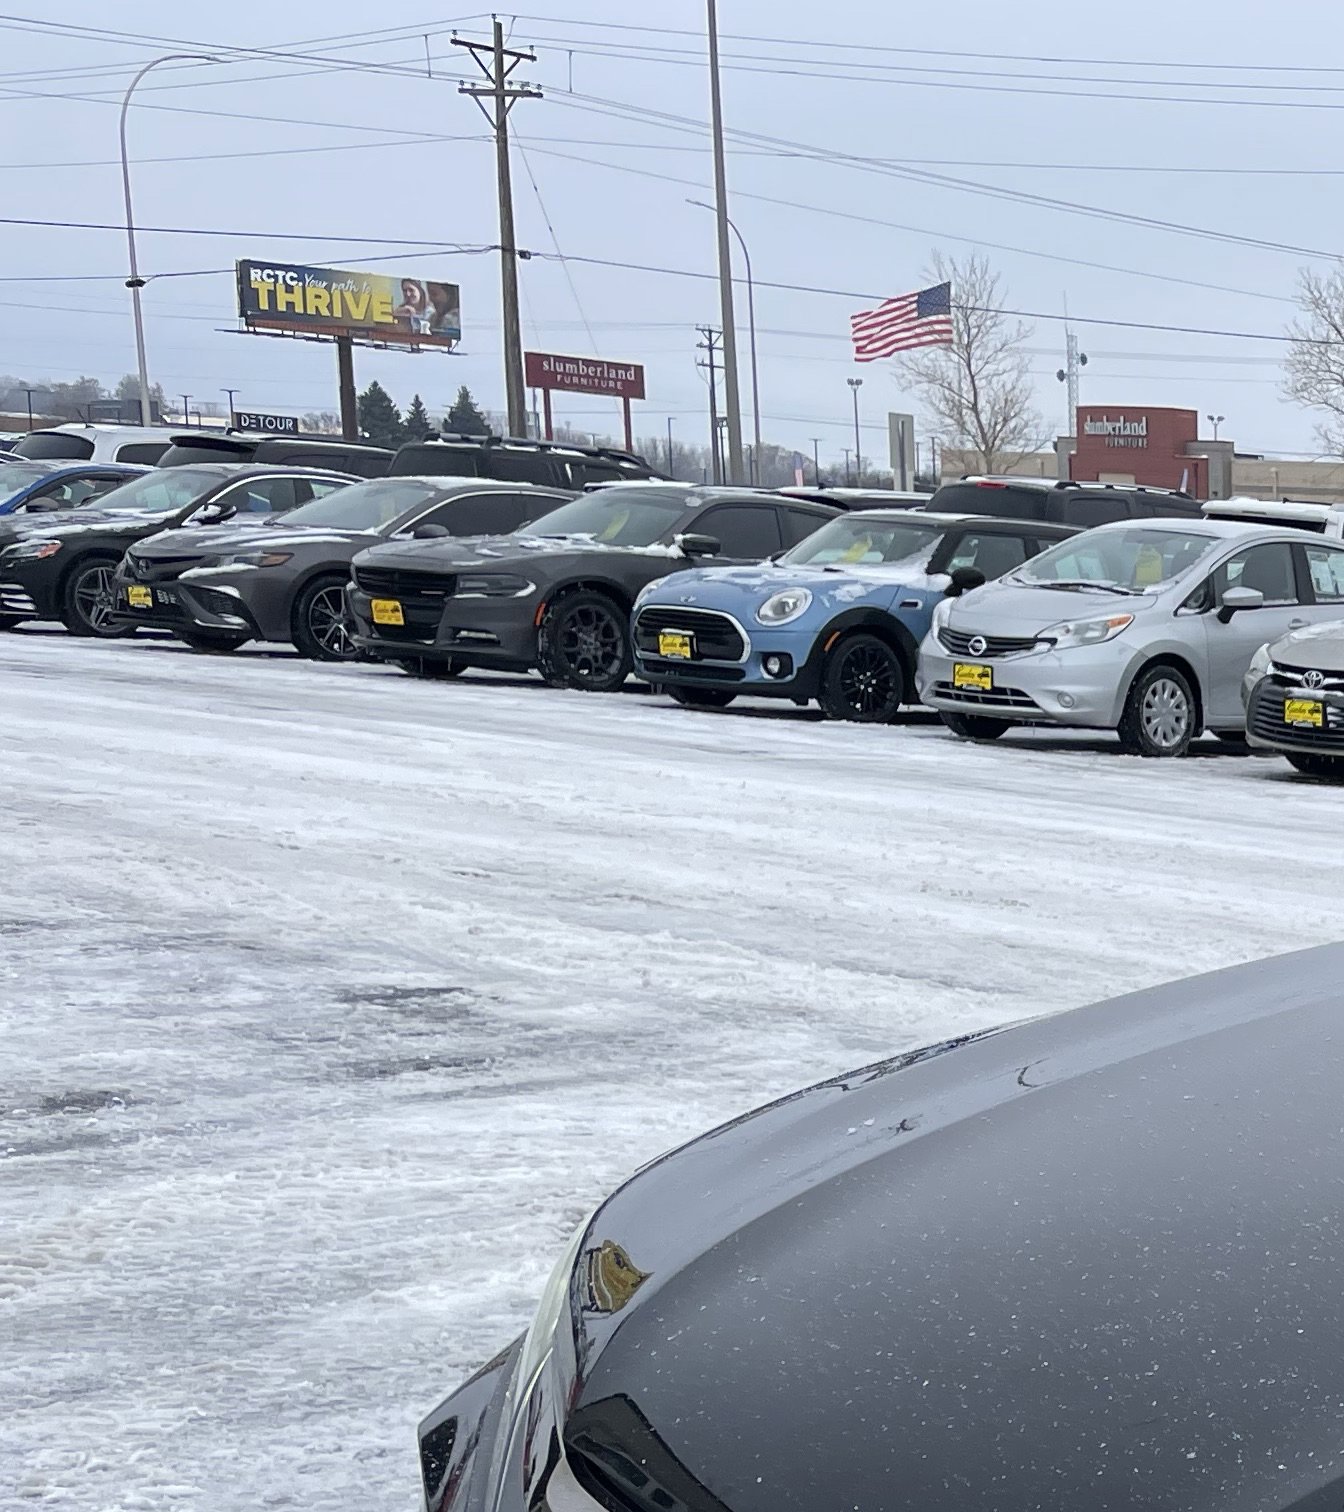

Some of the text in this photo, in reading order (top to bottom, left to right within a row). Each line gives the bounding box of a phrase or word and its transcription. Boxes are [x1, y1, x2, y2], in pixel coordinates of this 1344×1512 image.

[250, 267, 303, 287] RCTC.
[303, 273, 329, 289] Your
[331, 279, 359, 295] path
[251, 280, 399, 325] THRIVE.
[543, 357, 635, 381] slumberland
[557, 374, 624, 390] FURNITURE
[241, 414, 294, 431] DETOUR
